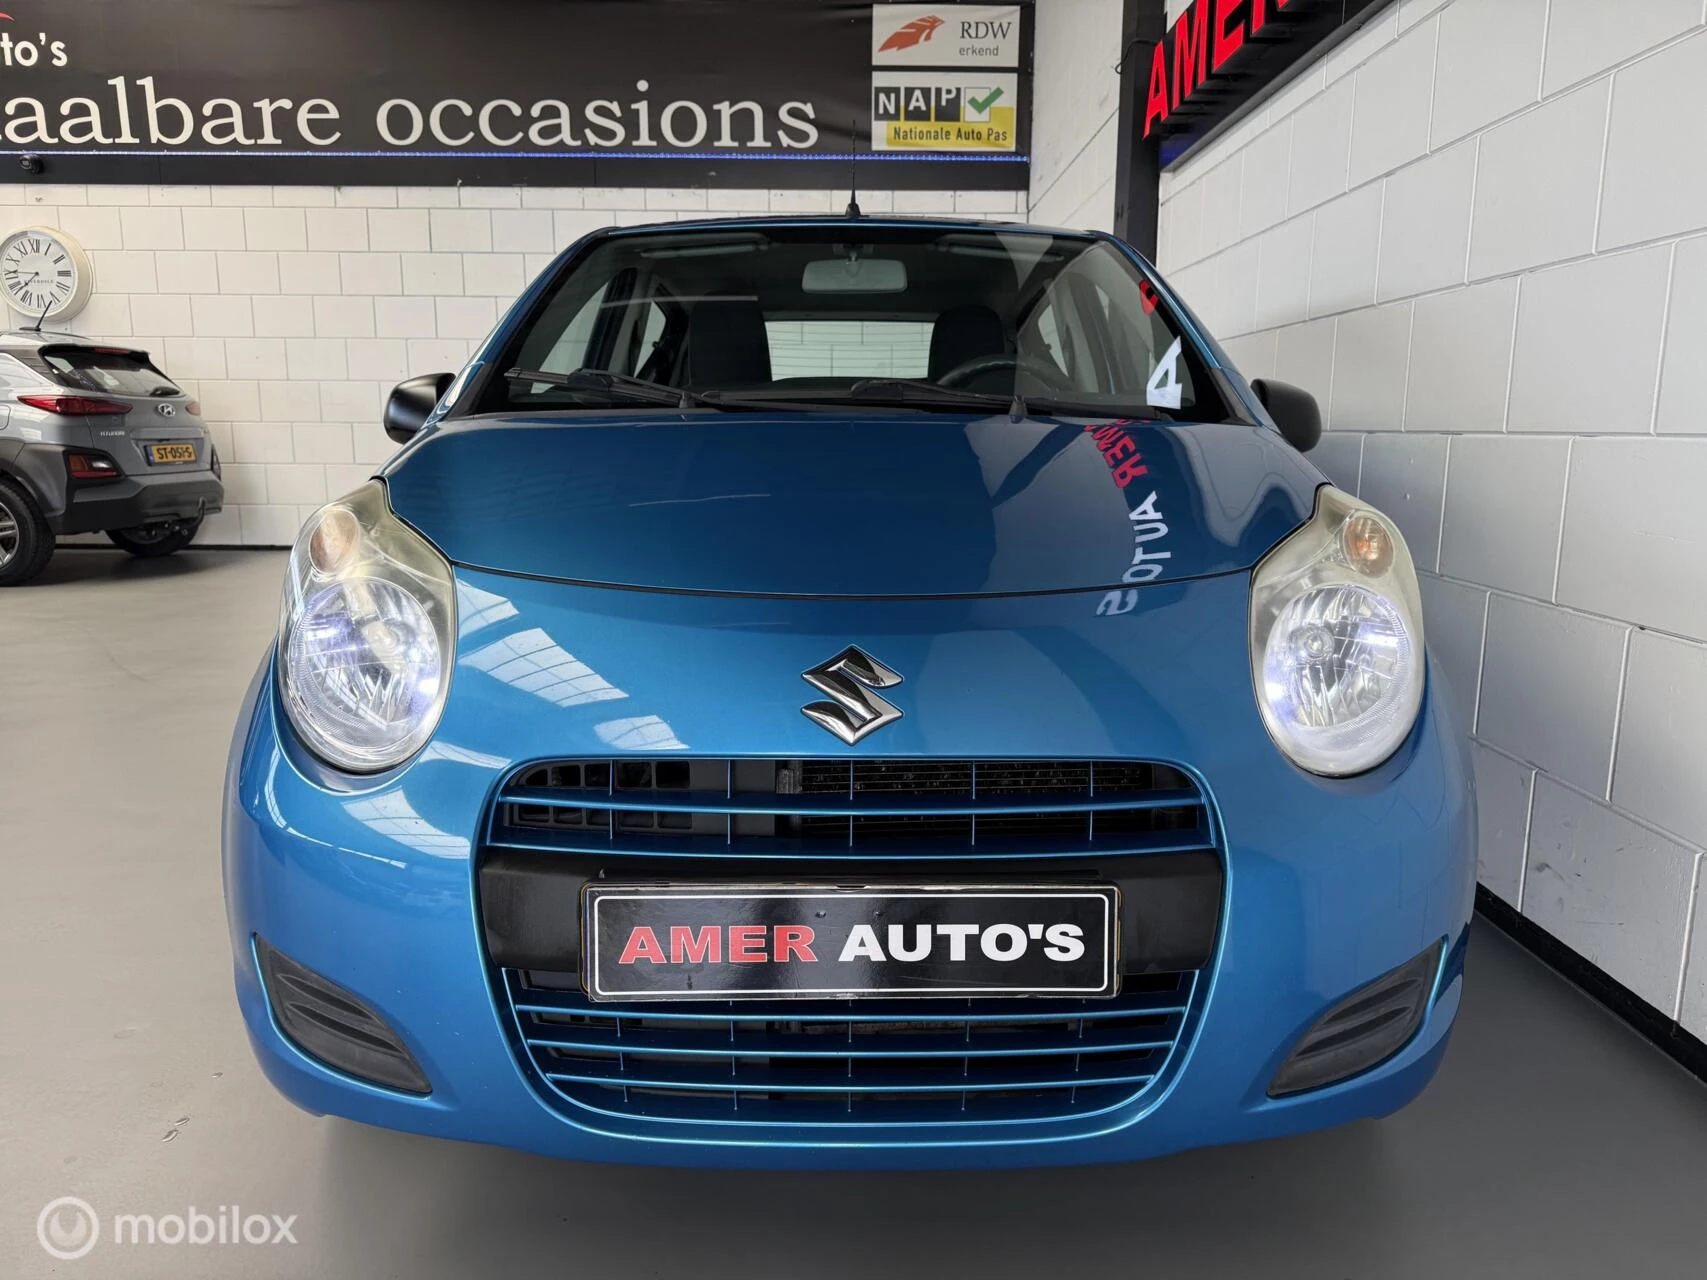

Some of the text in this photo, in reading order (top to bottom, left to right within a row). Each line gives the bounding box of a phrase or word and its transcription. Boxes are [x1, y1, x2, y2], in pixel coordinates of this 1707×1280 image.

[959, 21, 1012, 40] RDW
[959, 45, 1000, 57] erkend
[1143, 0, 1289, 140] AME
[0, 76, 819, 149] aalbare occasions
[878, 86, 957, 115] NAP
[893, 127, 1007, 142] Nationale Auto Pas
[618, 923, 1086, 964] AMER AUTO'S
